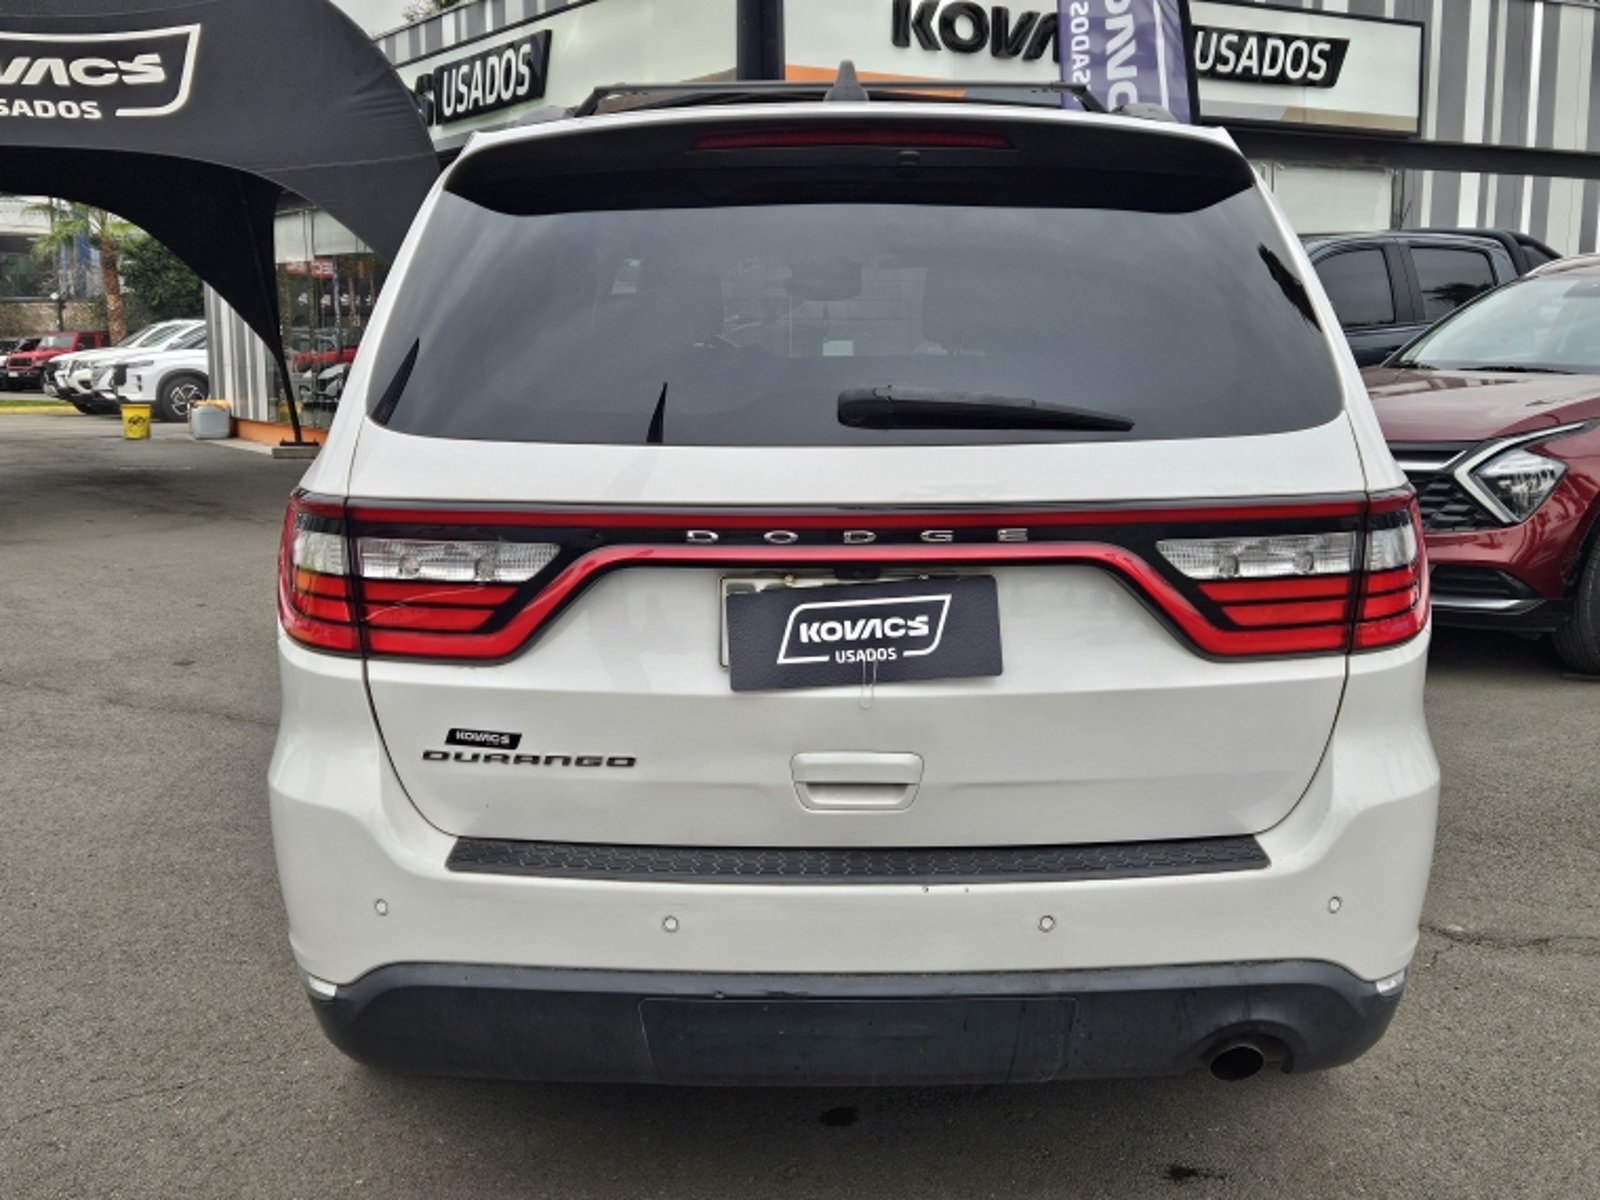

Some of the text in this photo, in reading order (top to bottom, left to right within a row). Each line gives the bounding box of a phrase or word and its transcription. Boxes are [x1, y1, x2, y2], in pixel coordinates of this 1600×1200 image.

[1194, 31, 1331, 80] USADOS
[442, 43, 531, 117] USADOS
[685, 530, 1028, 543] DODGE
[800, 614, 929, 643] KOVACS
[835, 648, 897, 664] USADOS
[456, 730, 510, 744] KOVACS
[422, 750, 637, 767] DURANGO
